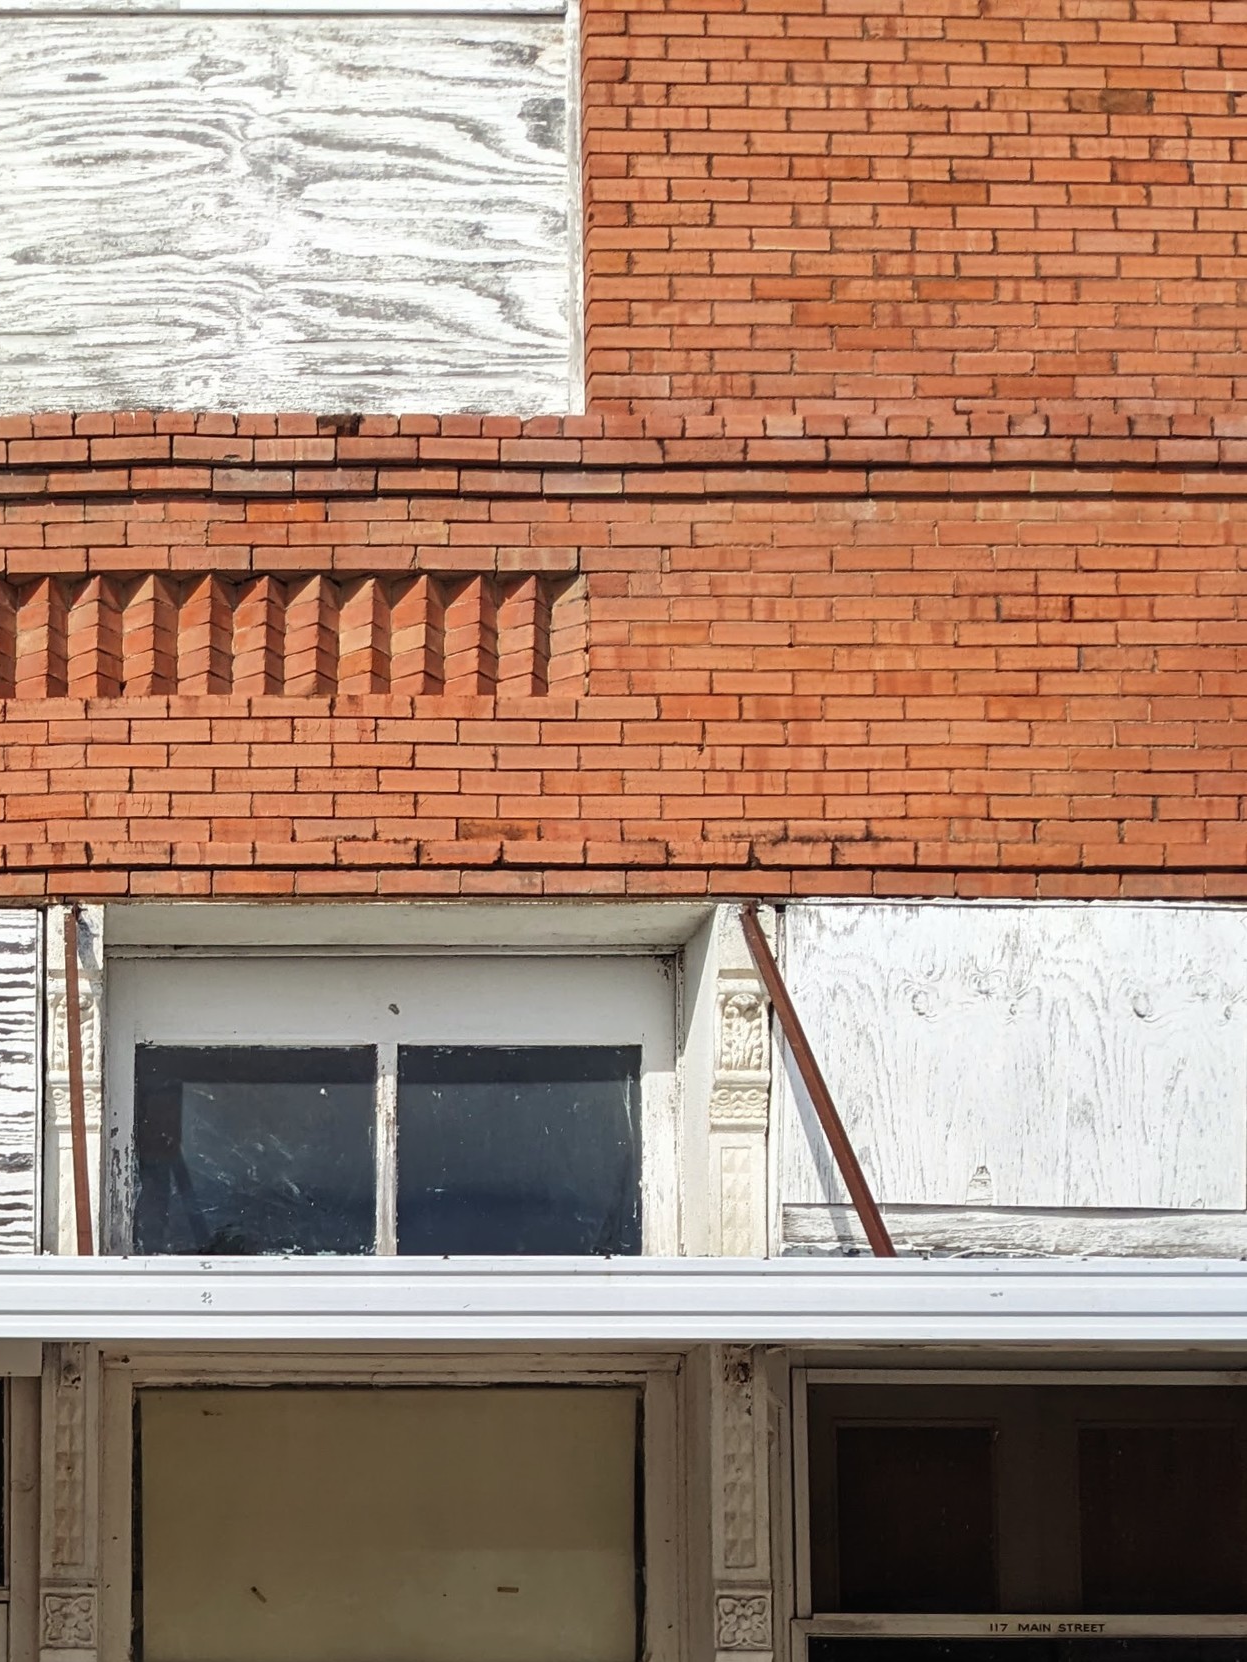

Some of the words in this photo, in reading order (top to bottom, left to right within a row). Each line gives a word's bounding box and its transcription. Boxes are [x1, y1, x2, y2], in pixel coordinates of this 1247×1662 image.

[989, 1623, 1009, 1632] 117
[1018, 1623, 1051, 1632] MAIN
[1058, 1623, 1105, 1633] STREET
